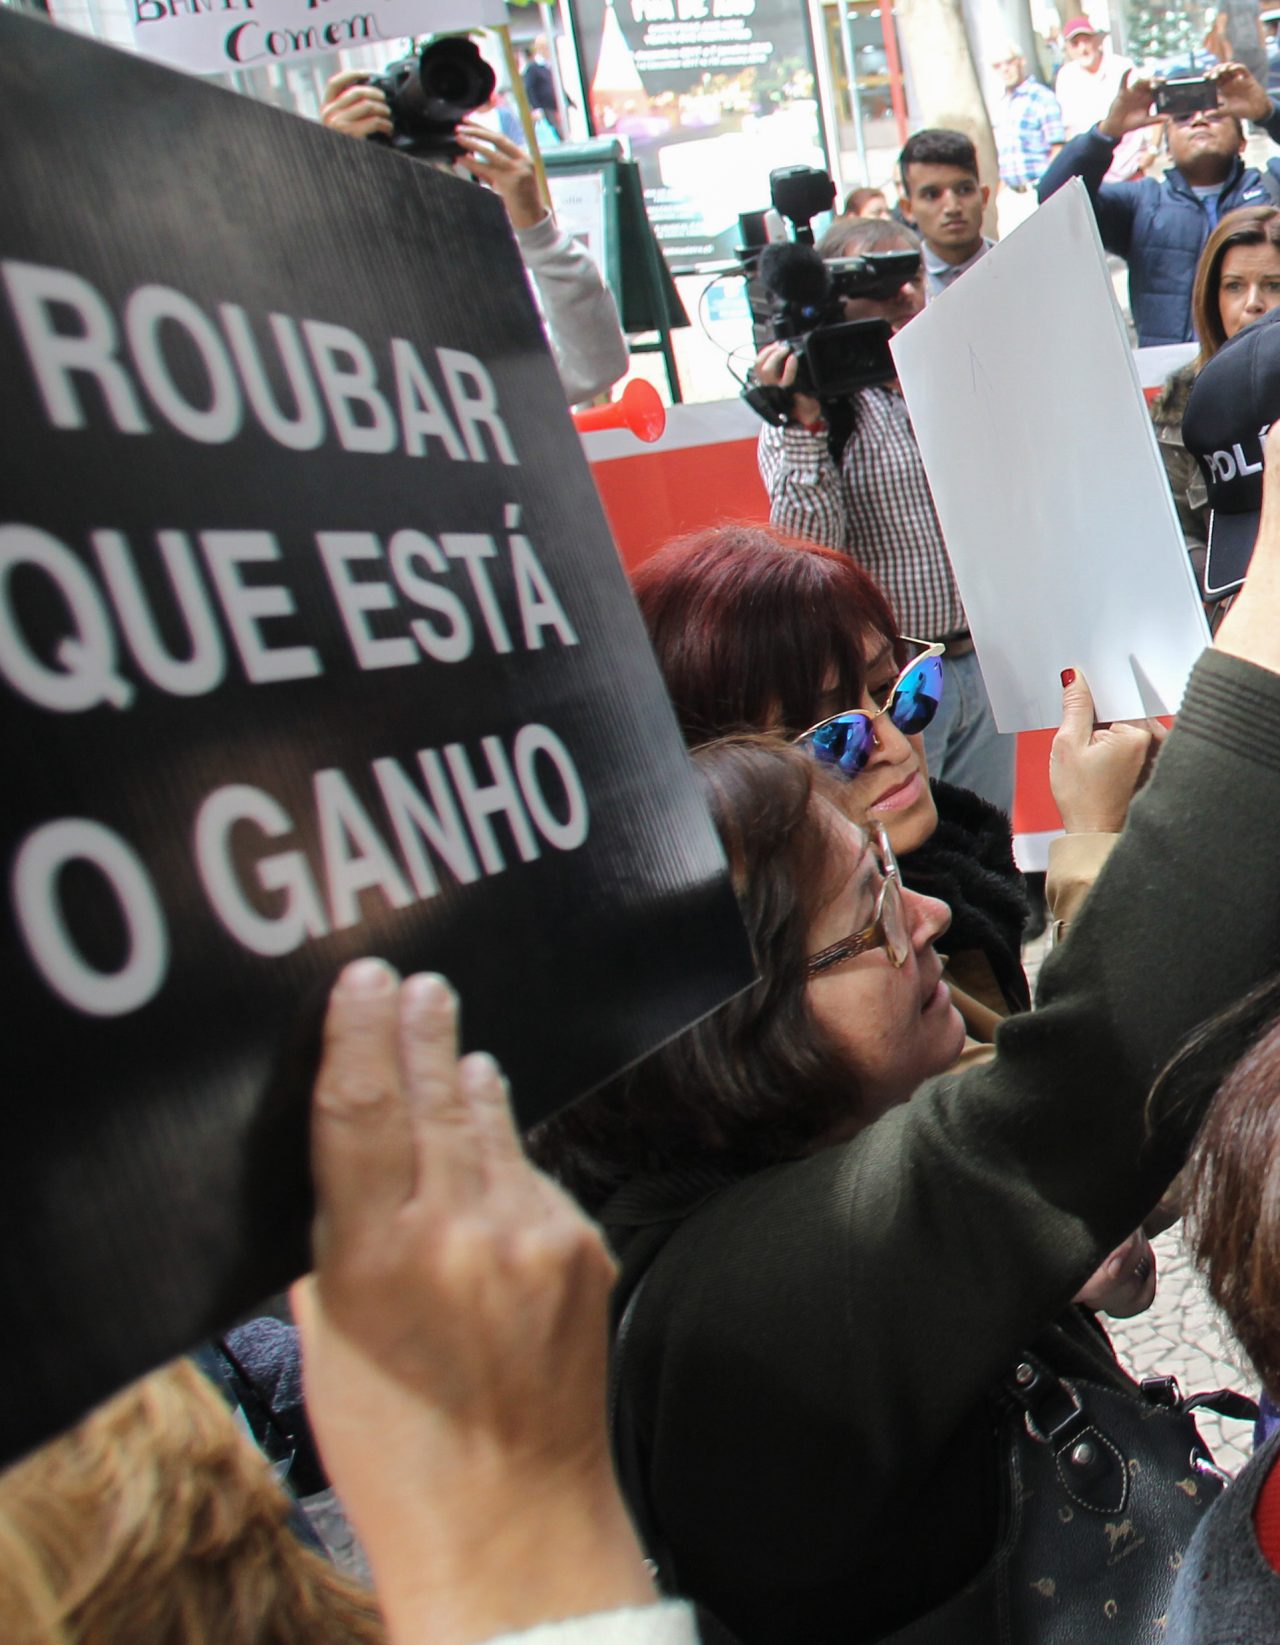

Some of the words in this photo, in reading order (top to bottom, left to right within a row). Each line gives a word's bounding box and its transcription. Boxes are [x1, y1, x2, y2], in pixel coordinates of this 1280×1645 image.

[225, 13, 386, 63] Comem
[3, 259, 519, 466] ROUBAR
[1202, 423, 1271, 485] POLÍ
[0, 522, 324, 713] QUE
[315, 504, 580, 671] ESTÁ
[12, 817, 171, 1018] O
[193, 722, 591, 958] GANHO
